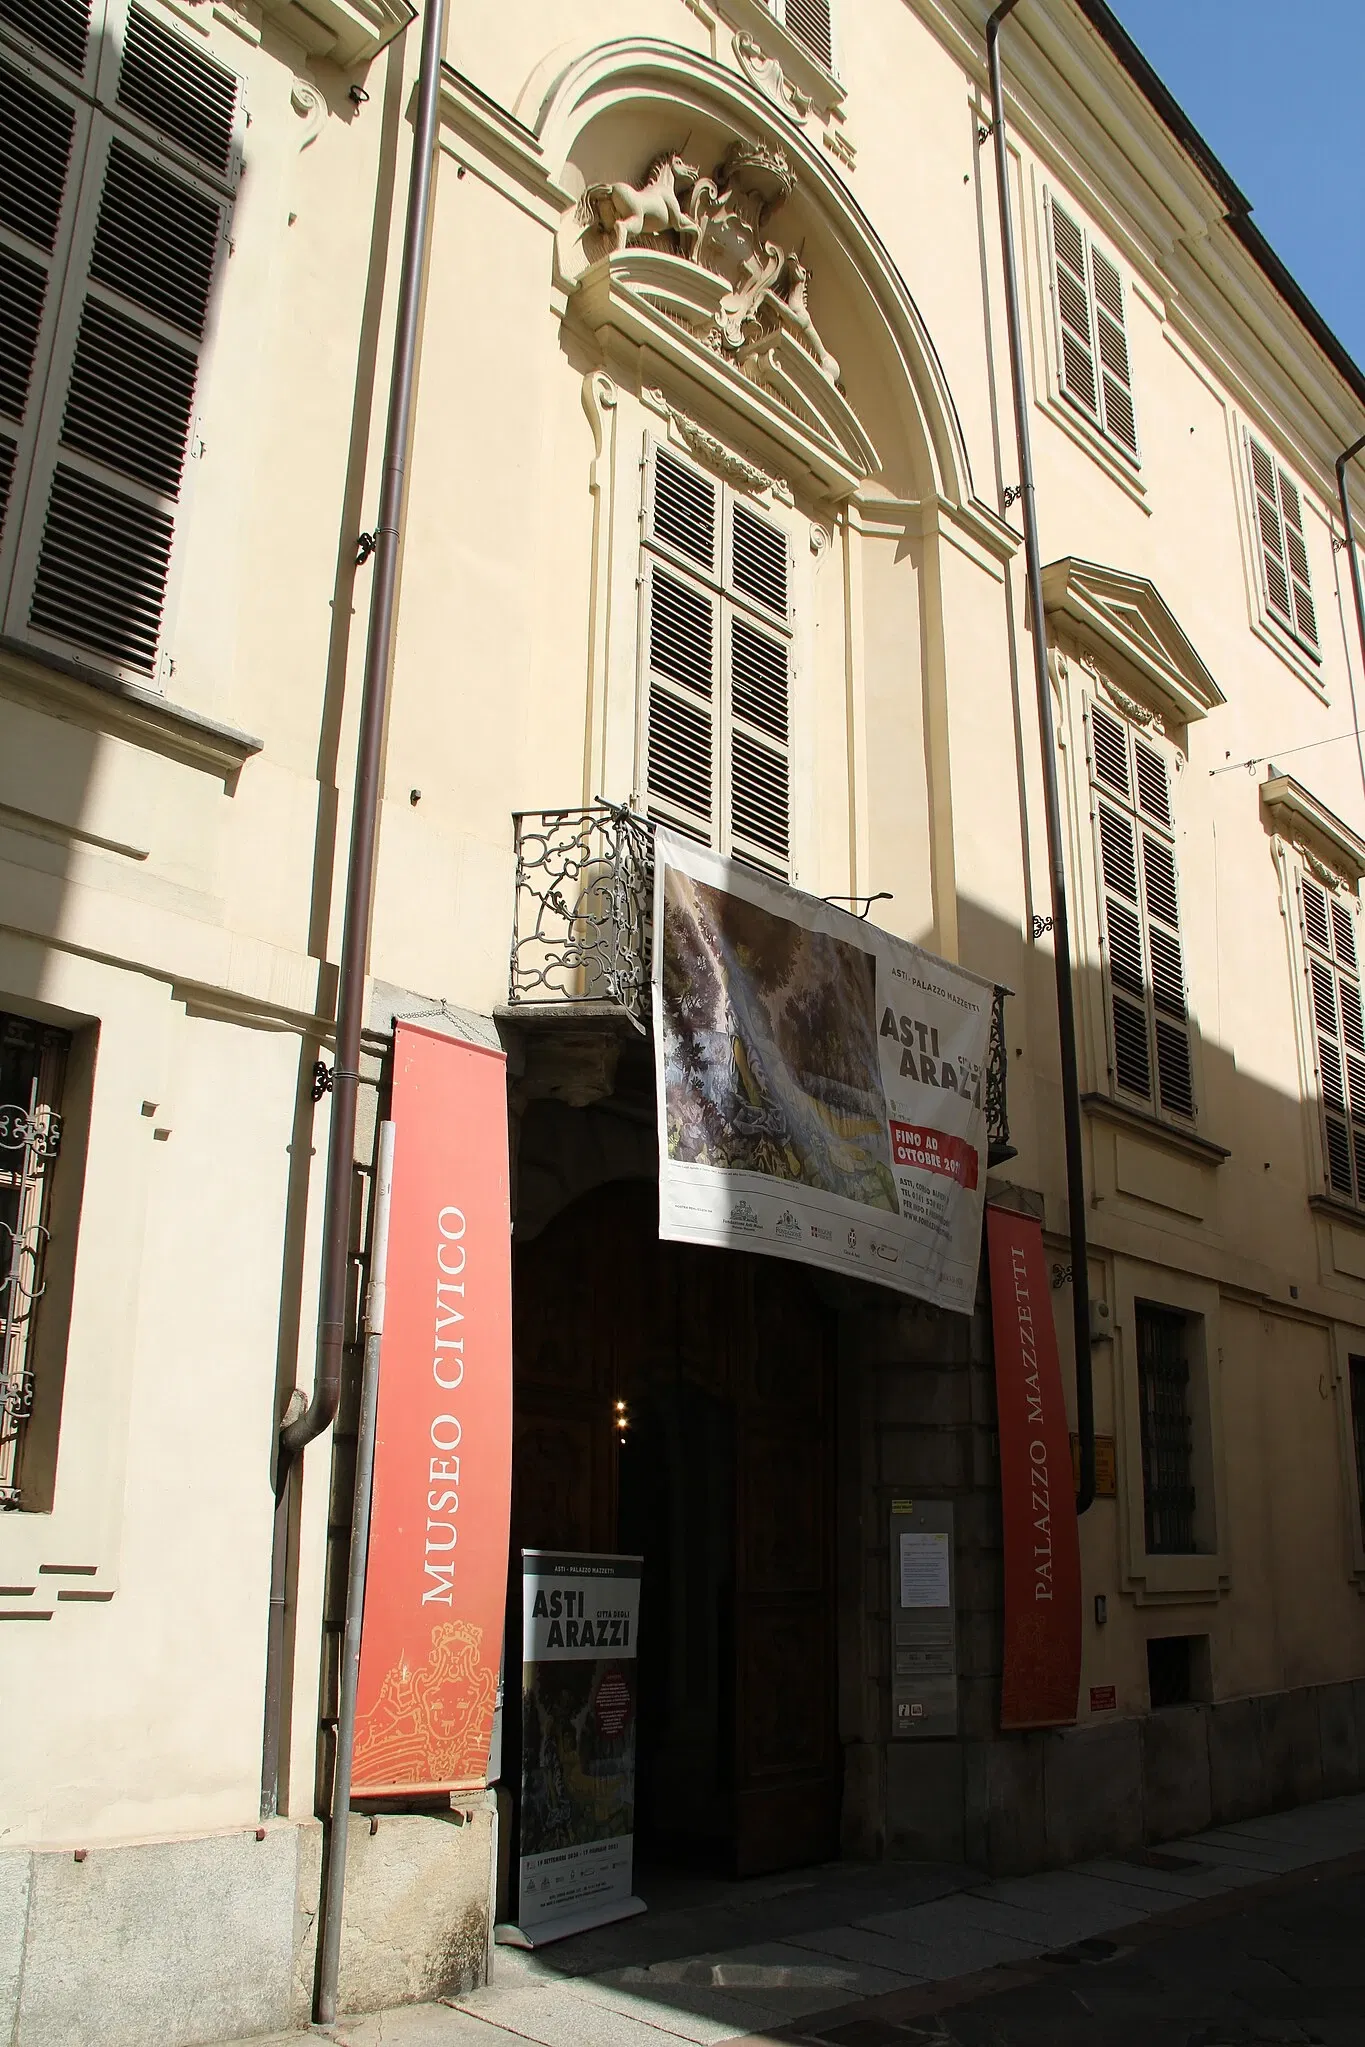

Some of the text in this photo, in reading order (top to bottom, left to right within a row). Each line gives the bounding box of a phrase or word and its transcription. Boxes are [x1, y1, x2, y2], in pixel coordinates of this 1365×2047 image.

[891, 967, 908, 981] ASTI
[912, 977, 946, 998] PALAZZO
[947, 991, 980, 1012] MAZZETTI
[879, 1006, 940, 1058] ASTI
[895, 1129, 938, 1151] FINO AD
[897, 1146, 941, 1168] OTTOBRE
[901, 1188, 911, 1198] TEL
[421, 1205, 467, 1607] MUSEO CIVICO
[1011, 1246, 1053, 1601] PALAZZO MAZZETTI
[532, 1589, 584, 1619] ASTI
[613, 1610, 630, 1618] DEGLI
[546, 1620, 630, 1648] ARAZZI
[543, 1856, 567, 1866] SETTEMBRE
